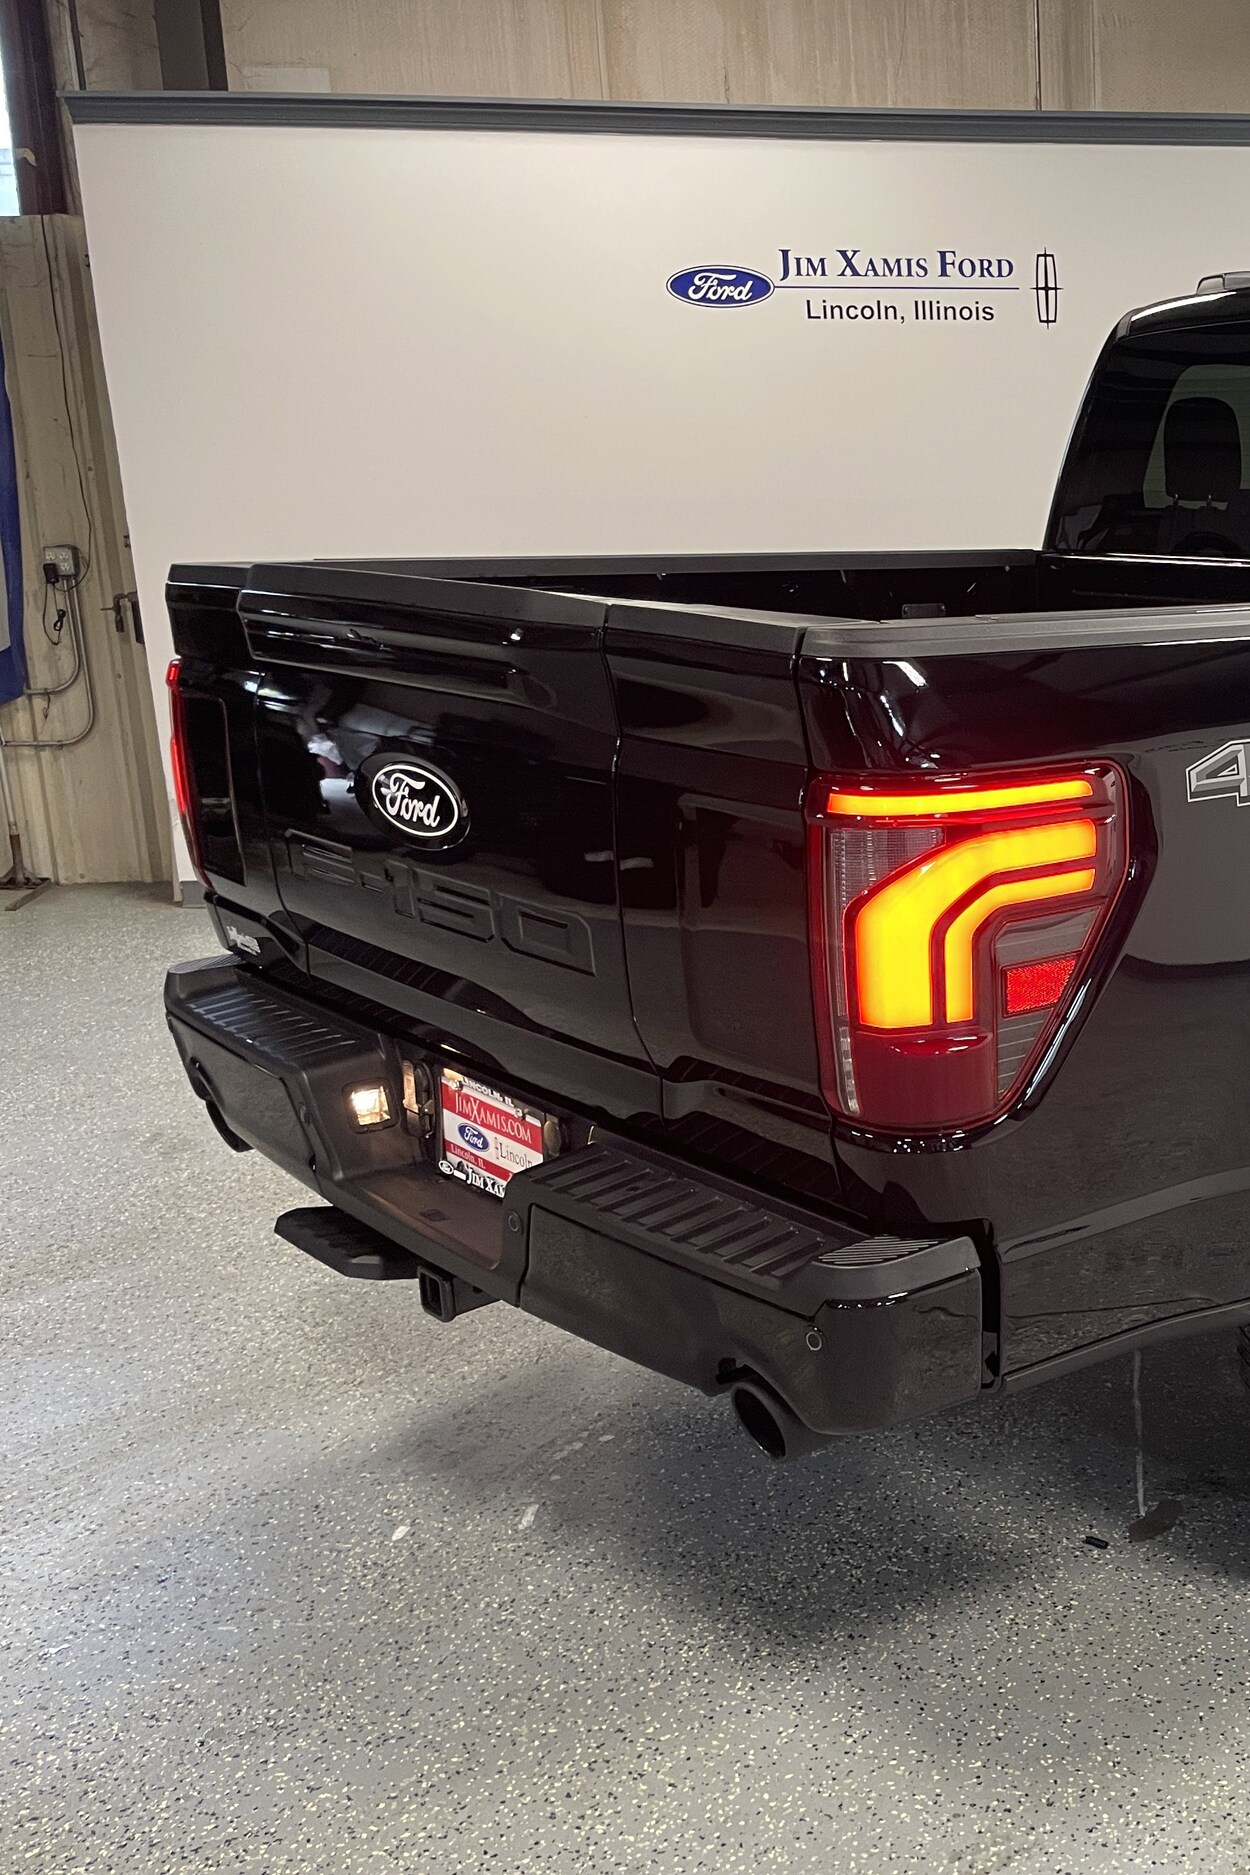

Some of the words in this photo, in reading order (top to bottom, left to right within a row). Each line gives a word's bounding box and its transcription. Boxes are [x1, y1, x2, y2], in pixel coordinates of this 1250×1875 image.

[778, 248, 828, 281] JIM
[835, 249, 929, 278] XAMIS
[937, 250, 1014, 278] FORD
[688, 271, 753, 301] Ford
[806, 299, 905, 323] Lincoln,
[914, 299, 995, 321] Illinois
[385, 772, 441, 829] Ford
[499, 1142, 533, 1168] Lincoln
